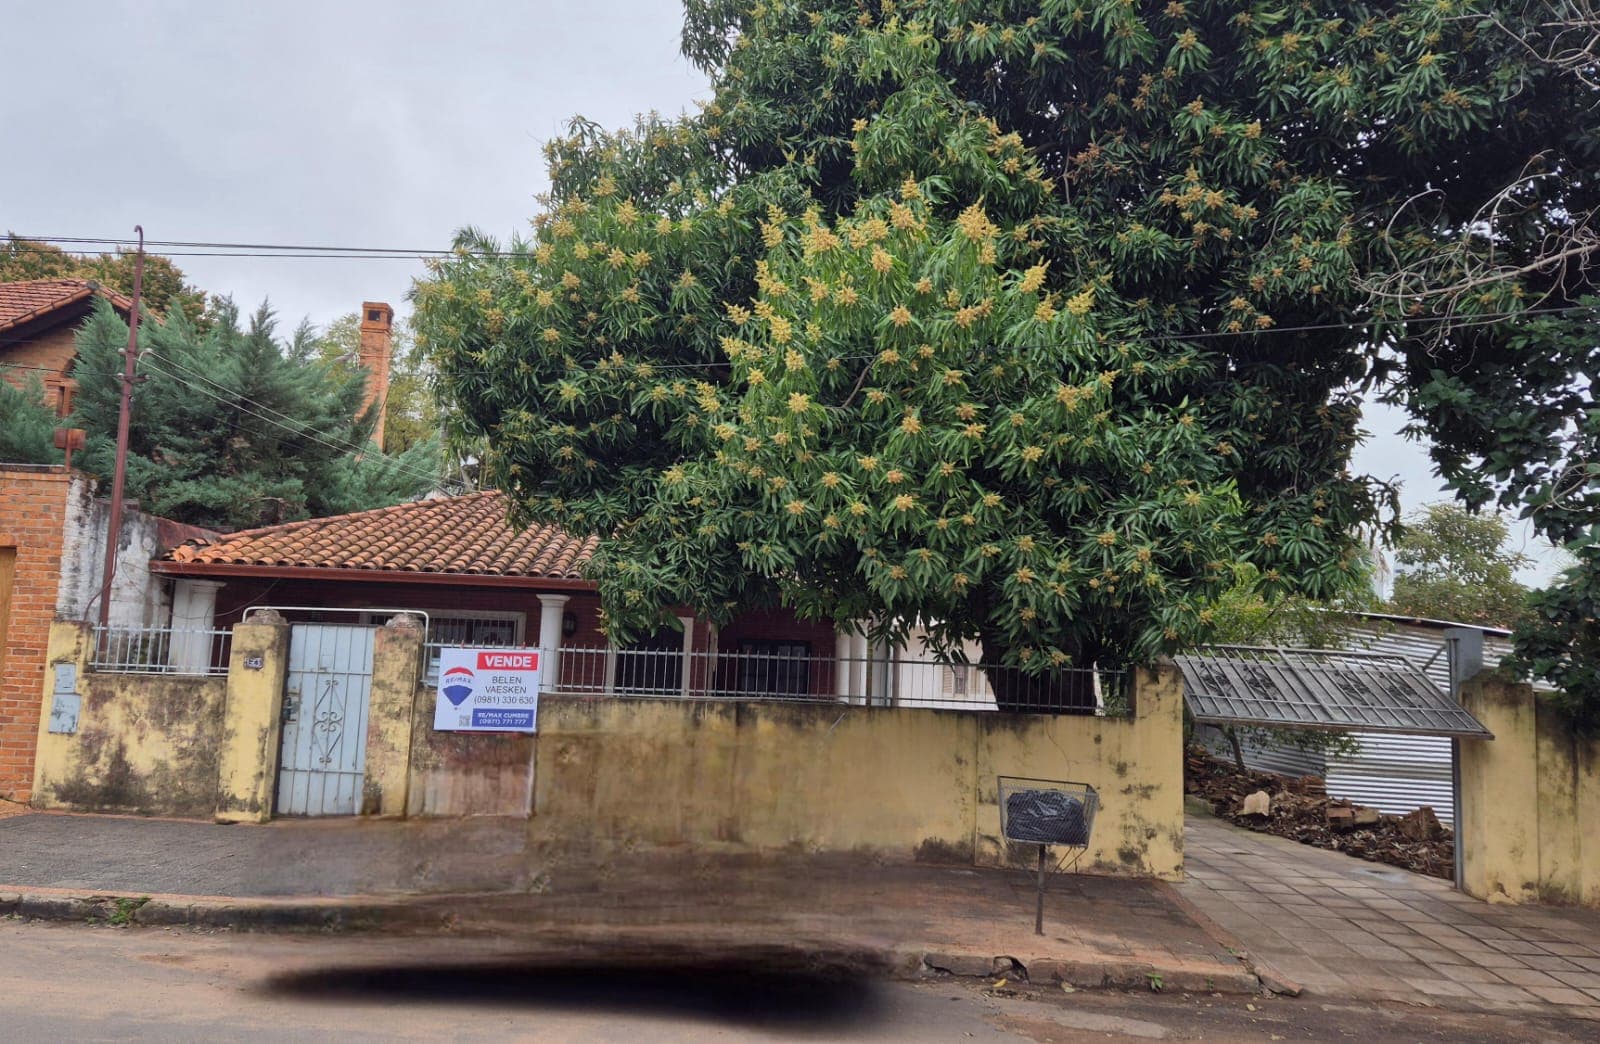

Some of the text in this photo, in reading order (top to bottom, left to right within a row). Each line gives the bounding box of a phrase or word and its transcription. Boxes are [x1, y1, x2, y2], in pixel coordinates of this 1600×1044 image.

[485, 655, 532, 667] VENDE
[445, 676, 471, 684] RE/MAX
[491, 676, 522, 684] BELEN
[485, 685, 527, 694] VAESKEN
[474, 695, 534, 704] (0981) 330 630
